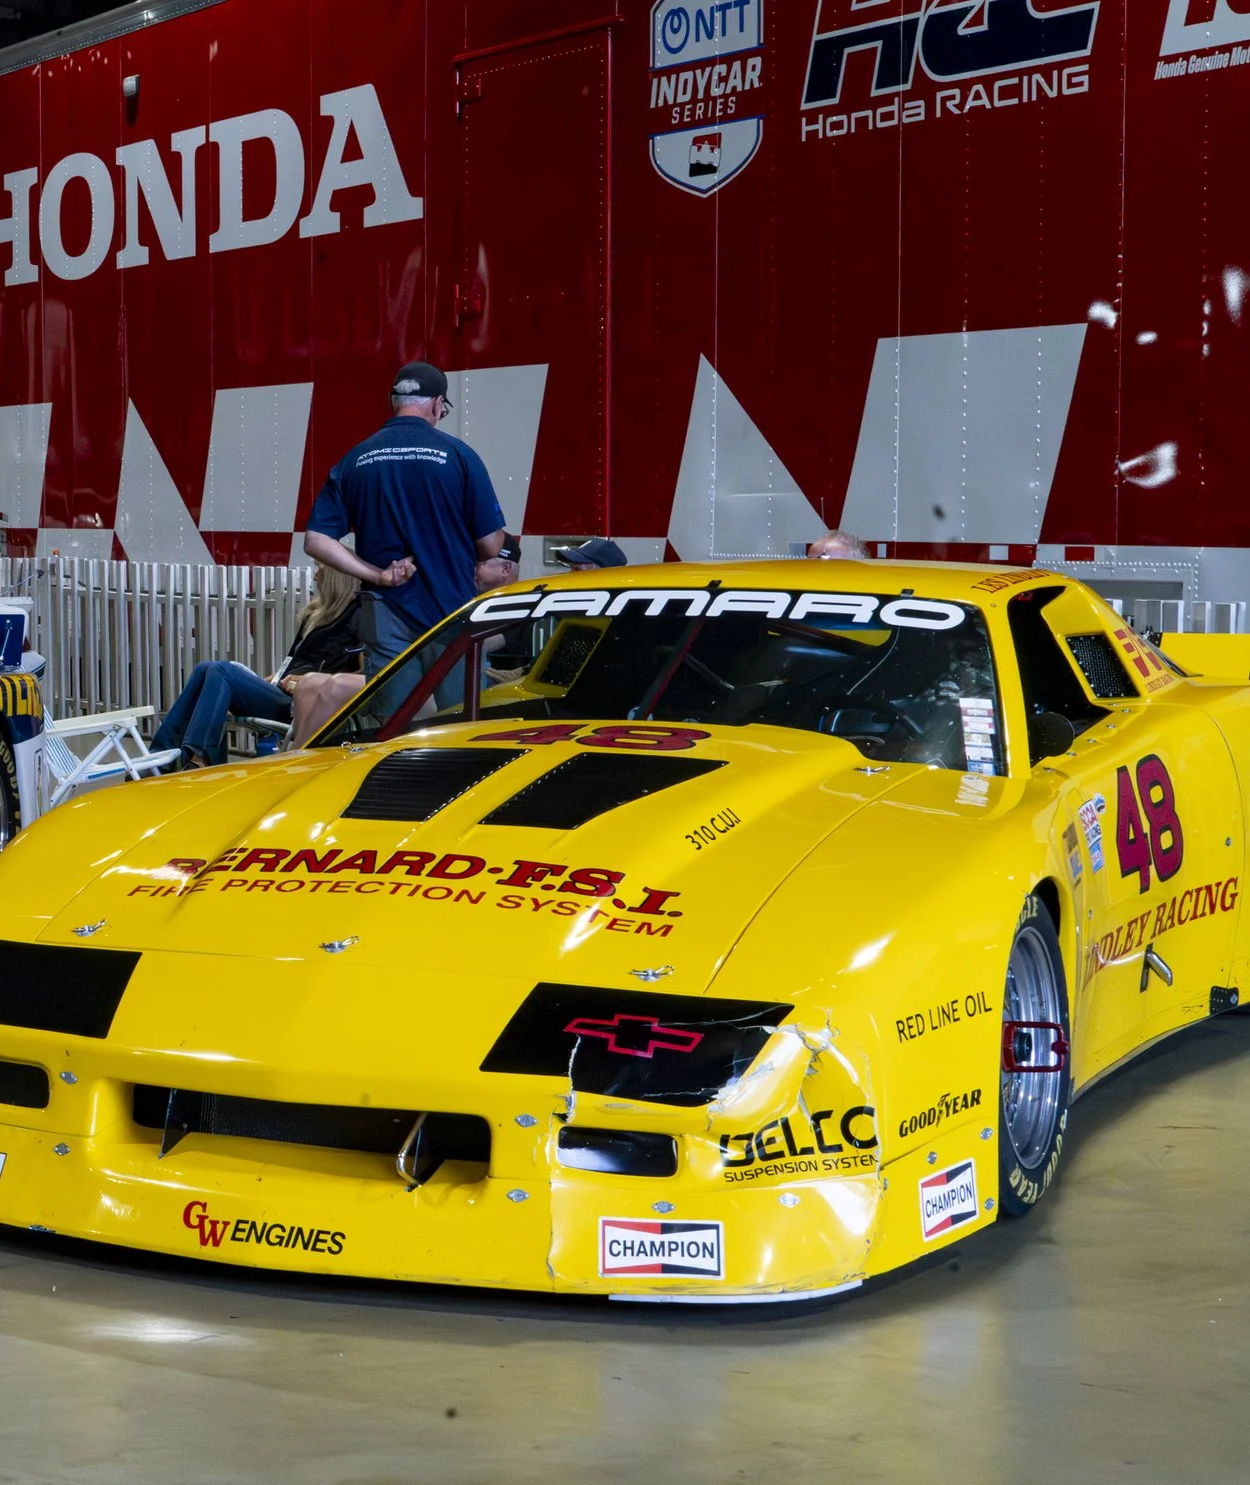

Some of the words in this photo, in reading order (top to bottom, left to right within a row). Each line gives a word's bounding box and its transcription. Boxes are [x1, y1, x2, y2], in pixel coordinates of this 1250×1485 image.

[695, 0, 751, 42] NTT
[650, 56, 760, 109] INDYCAR
[1153, 57, 1188, 81] Honda
[1187, 50, 1230, 74] Genuine
[670, 96, 737, 124] SERIES
[801, 97, 926, 142] Honda
[935, 63, 1090, 118] RACING
[373, 453, 404, 462] experience
[404, 453, 417, 461] with
[416, 453, 448, 465] knowledge
[469, 590, 966, 630] CAMARO
[468, 723, 713, 751] 48
[684, 825, 717, 851] 310
[1115, 752, 1183, 895] 48
[127, 879, 216, 898] FIRE
[220, 878, 486, 906] PROTECTION
[496, 896, 674, 938] SYSTEM
[1149, 876, 1239, 941] RACING
[896, 1009, 926, 1043] RED
[930, 1001, 962, 1032] LINE
[966, 990, 993, 1018] OIL
[724, 1158, 818, 1183] SUSPENSION
[924, 1181, 975, 1219] CHAMPION
[182, 1200, 232, 1248] GW
[231, 1219, 346, 1256] ENGINES
[608, 1237, 716, 1260] CHAMPION
